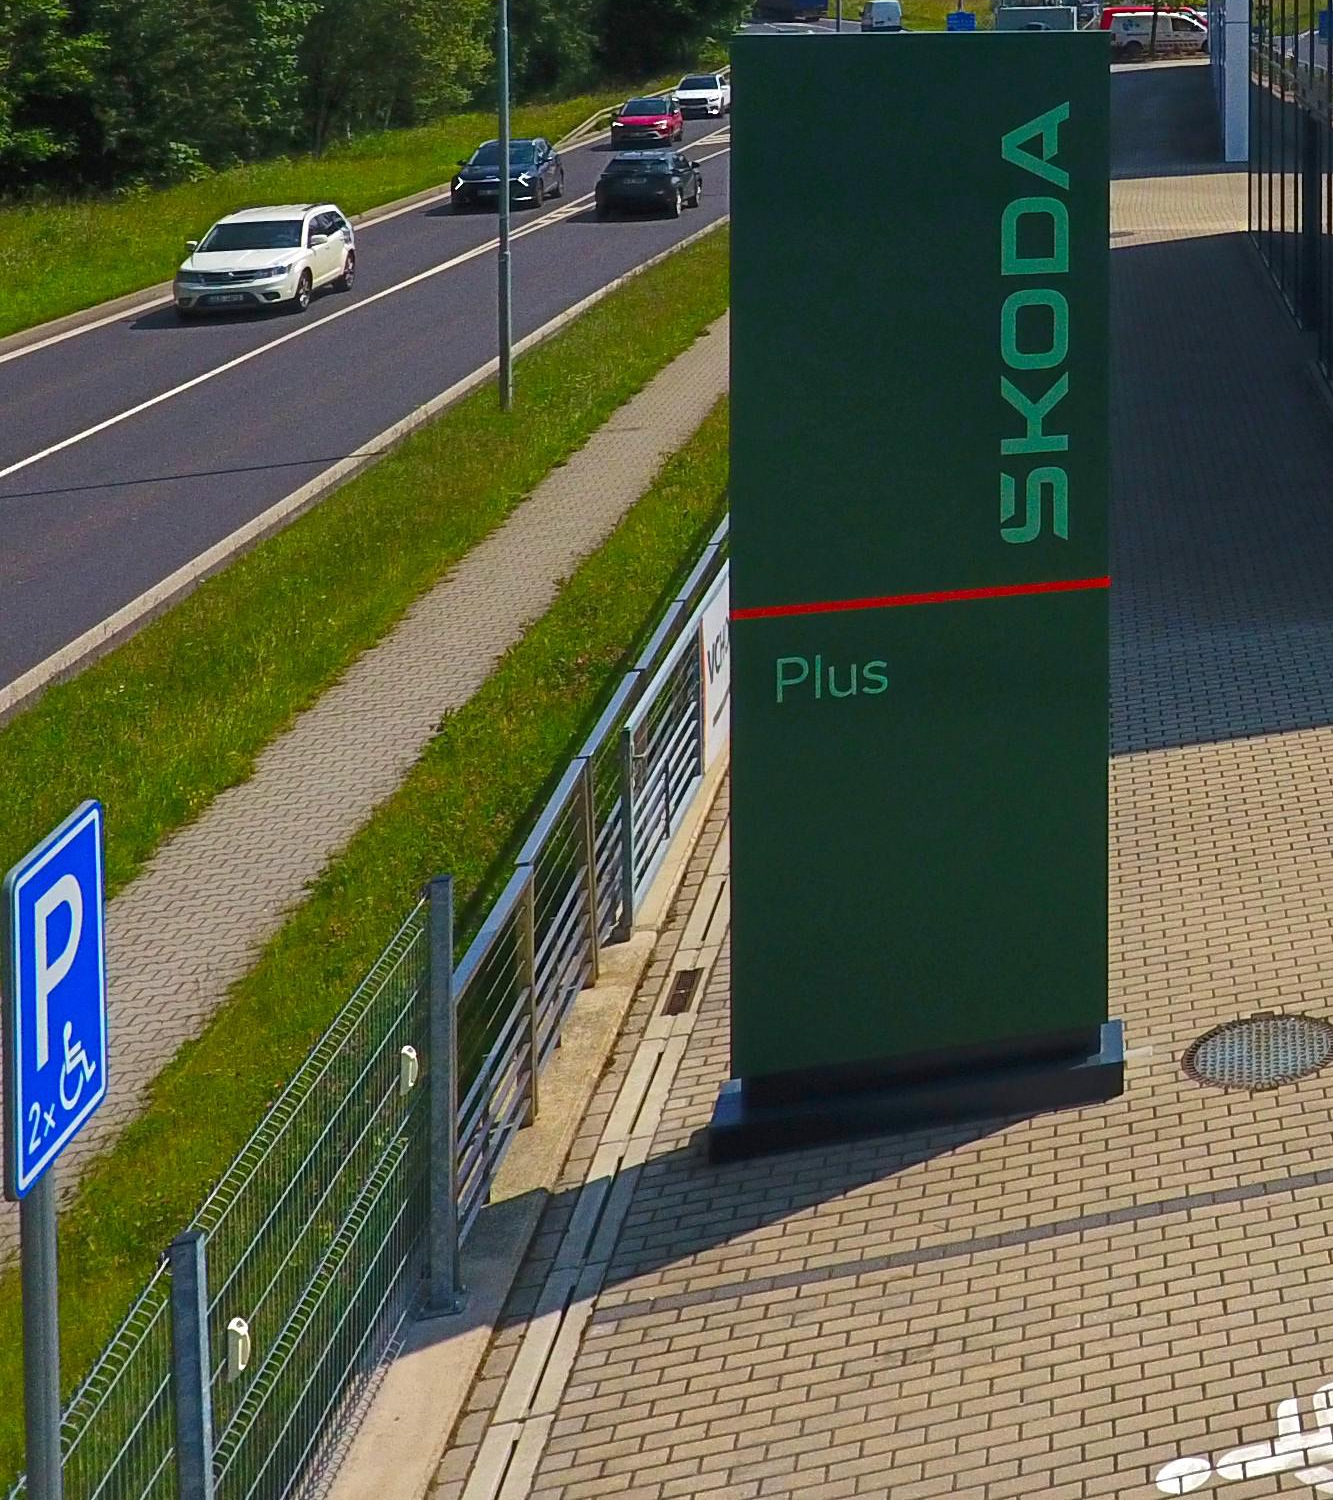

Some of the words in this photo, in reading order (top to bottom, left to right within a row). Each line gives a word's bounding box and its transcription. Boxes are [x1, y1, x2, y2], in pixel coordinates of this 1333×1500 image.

[776, 654, 889, 703] Plus
[35, 873, 83, 1072] P
[28, 1101, 56, 1155] 2x
